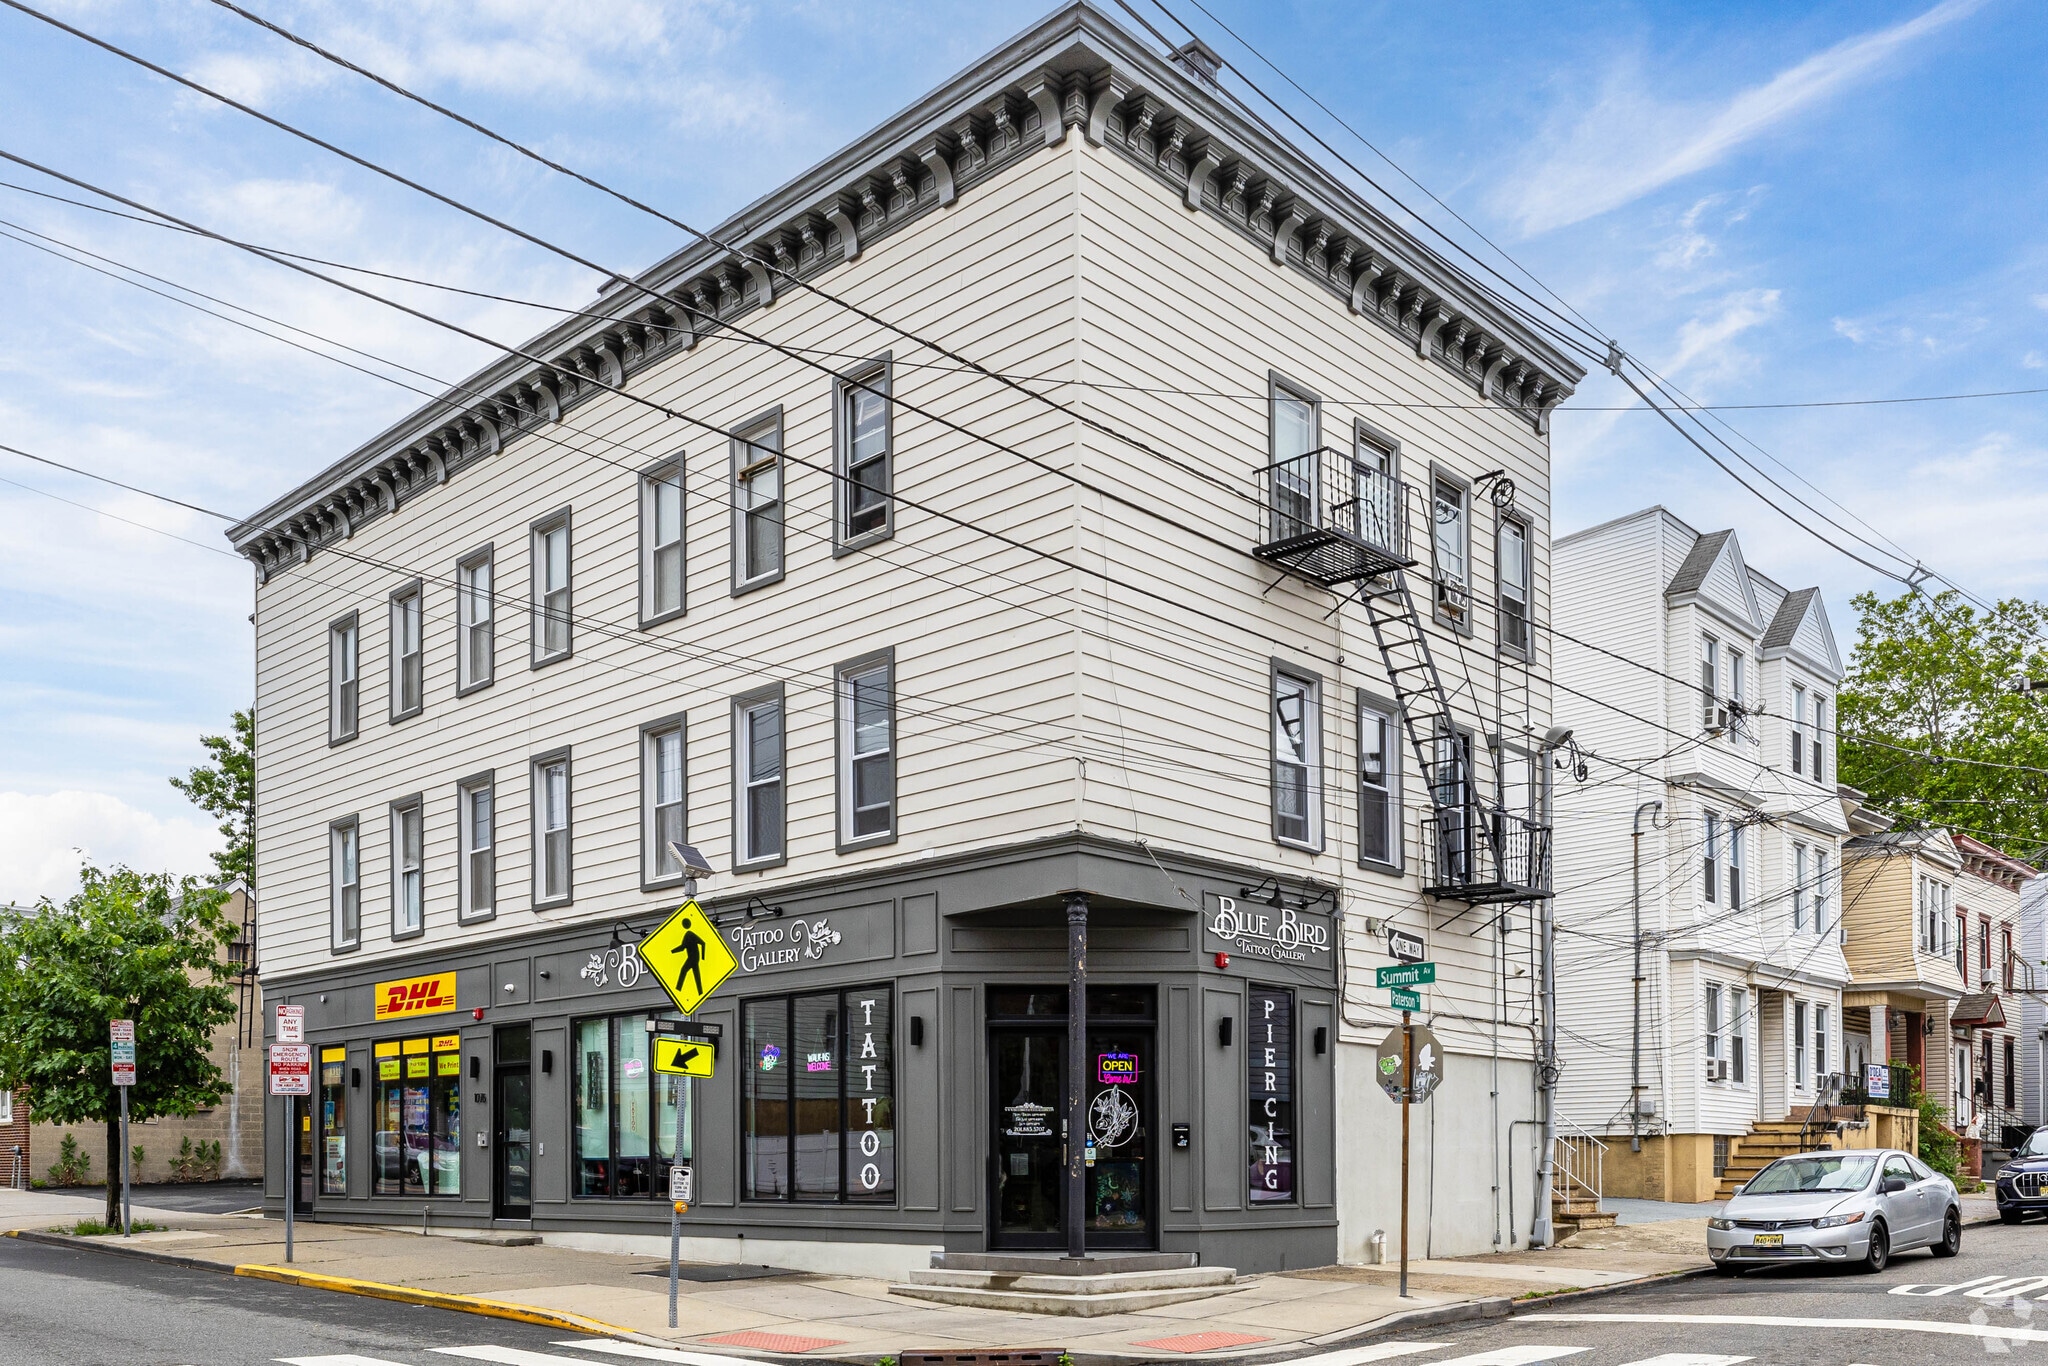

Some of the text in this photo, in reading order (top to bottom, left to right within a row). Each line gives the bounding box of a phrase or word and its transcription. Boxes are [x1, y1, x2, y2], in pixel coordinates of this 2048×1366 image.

[1395, 938, 1420, 956] ONE WAY
[1380, 967, 1431, 985] Summit Av
[387, 980, 443, 1013] DHL
[1391, 990, 1416, 1008] Paterson
[278, 1007, 286, 1015] NO
[438, 1039, 454, 1047] DHL
[447, 1061, 459, 1069] Print
[807, 1061, 831, 1072] WELCOME
[1103, 1060, 1133, 1071] OPEN
[860, 999, 881, 1190] TATTOO
[1263, 1000, 1278, 1190] PIERCING
